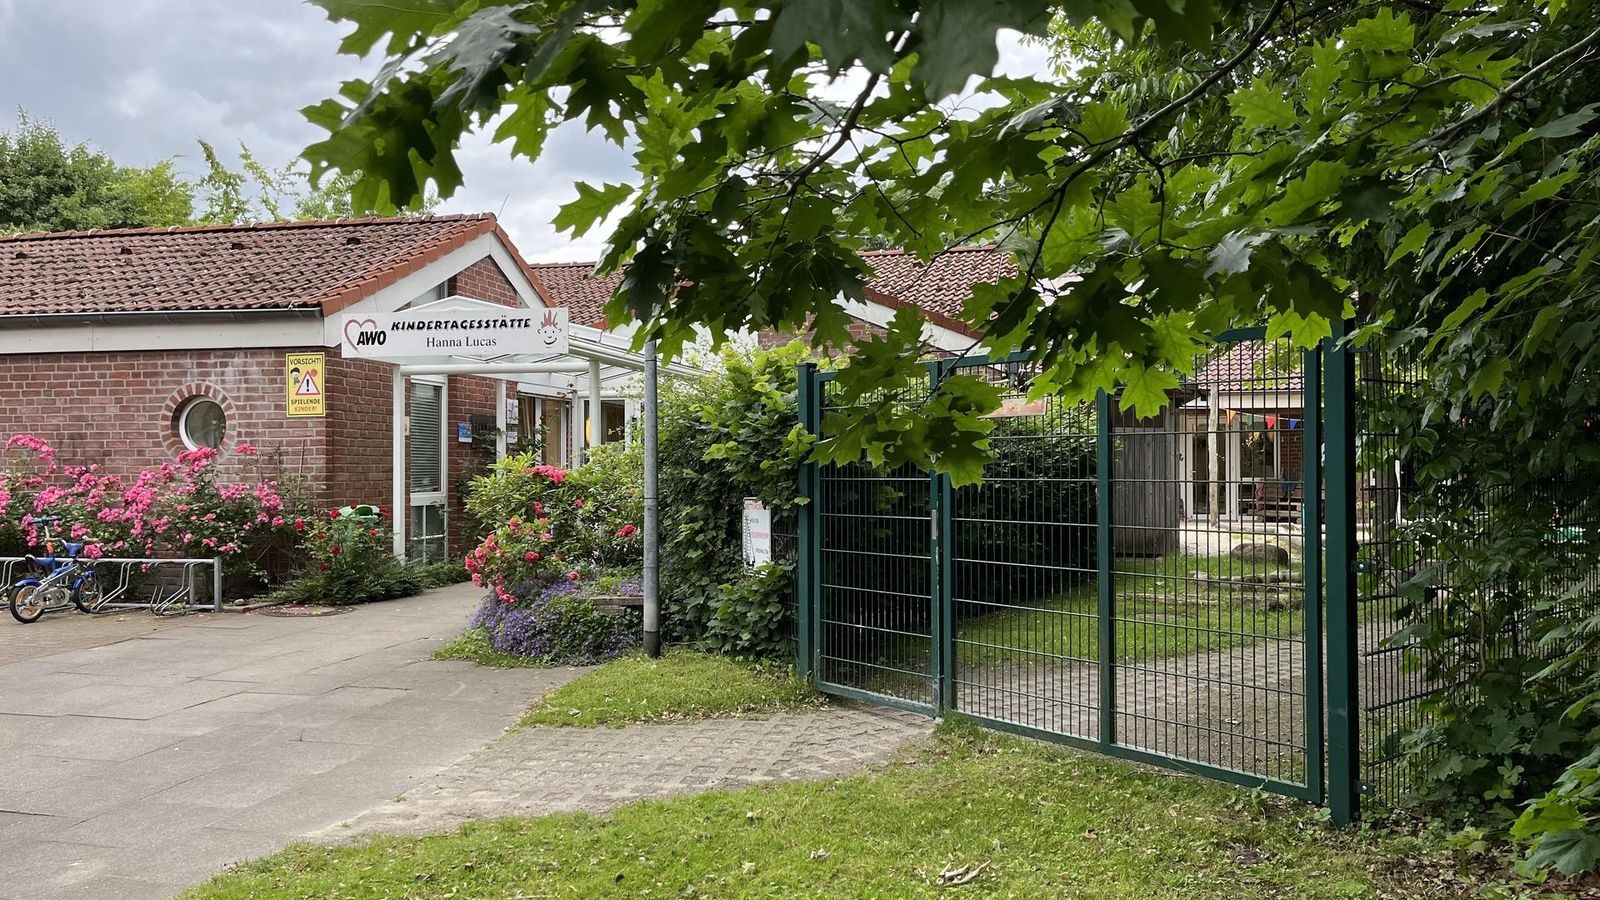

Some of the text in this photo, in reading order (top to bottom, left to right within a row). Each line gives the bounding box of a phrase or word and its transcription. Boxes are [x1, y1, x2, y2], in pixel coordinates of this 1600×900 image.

[391, 315, 531, 330] KINDERTAGESSTÄTTE
[357, 330, 387, 346] AWO
[426, 336, 497, 348] Hanna Lucas
